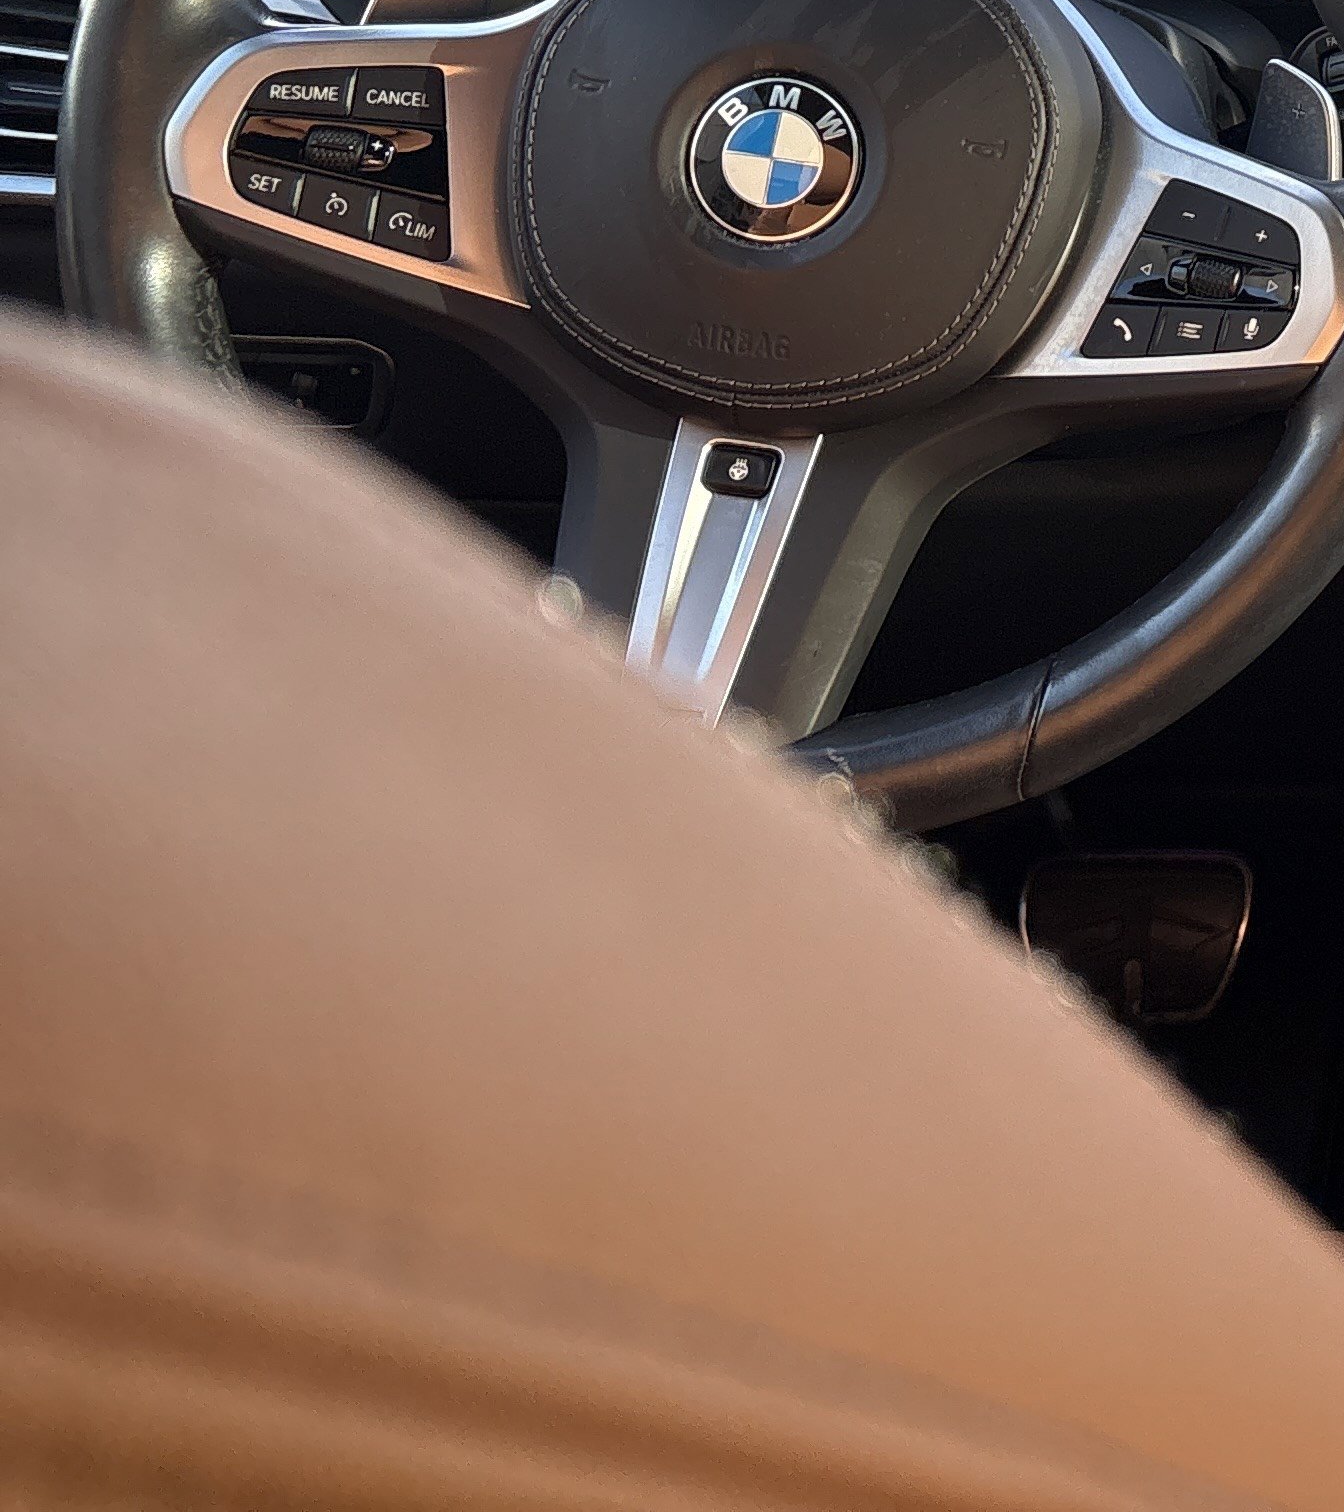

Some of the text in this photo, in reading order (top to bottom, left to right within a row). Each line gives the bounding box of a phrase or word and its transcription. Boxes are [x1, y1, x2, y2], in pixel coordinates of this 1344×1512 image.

[269, 84, 340, 102] RESUME
[366, 89, 430, 107] CANCEL
[717, 84, 847, 141] BMW
[247, 173, 282, 193] SET
[405, 219, 436, 241] LIM
[687, 320, 791, 361] AIRBAG
